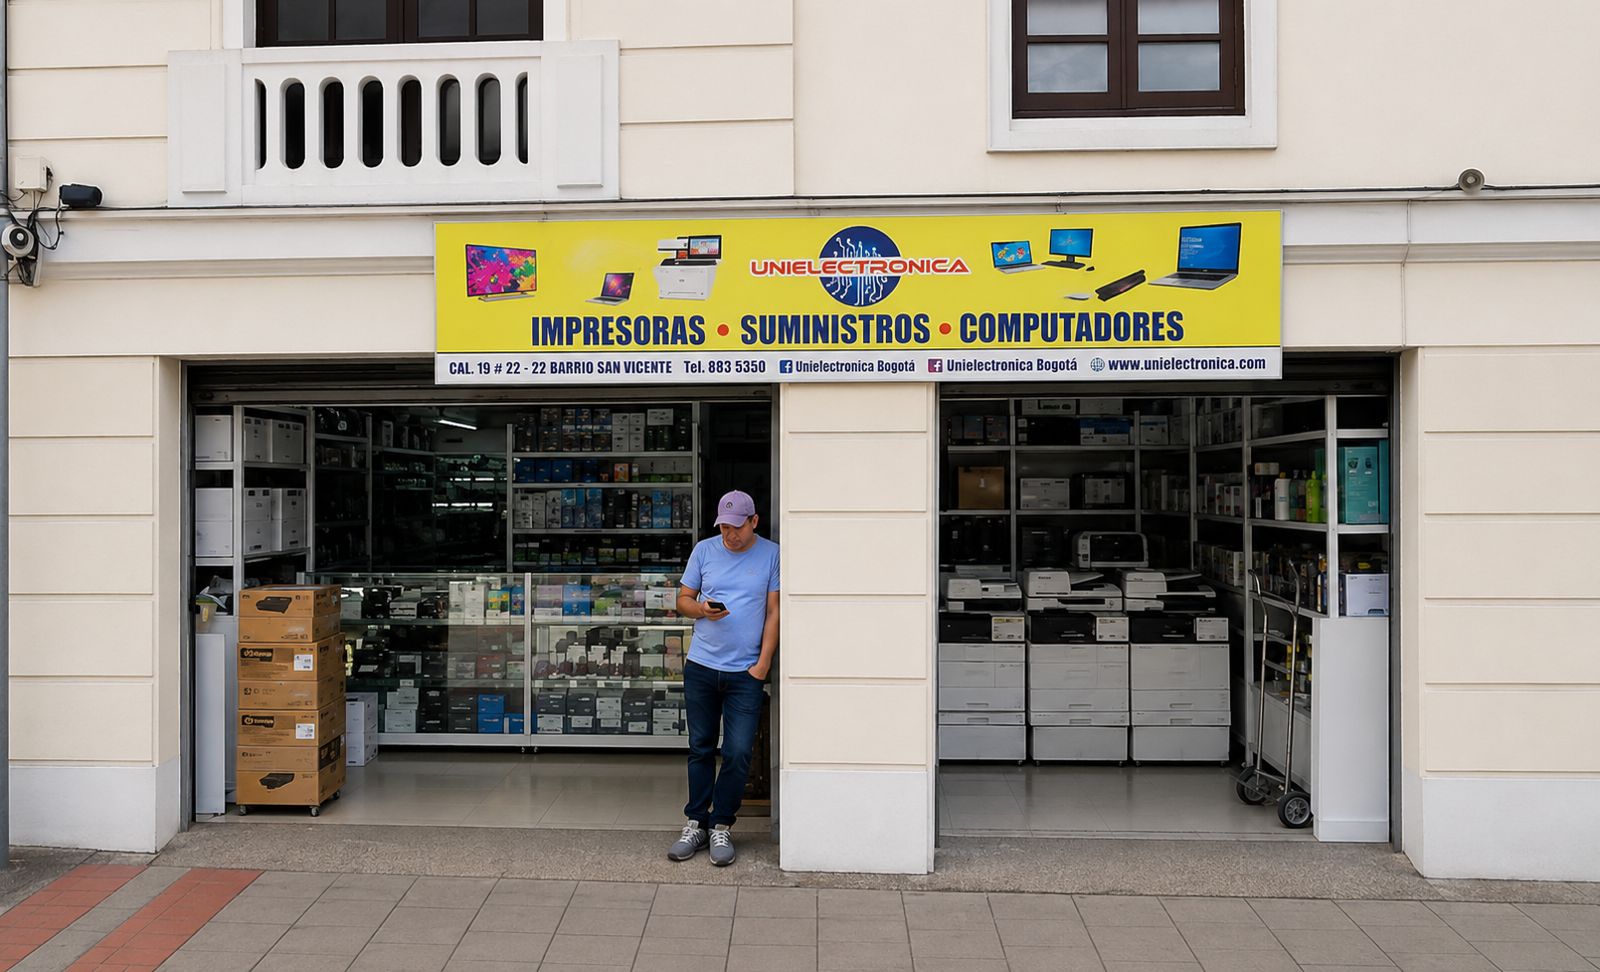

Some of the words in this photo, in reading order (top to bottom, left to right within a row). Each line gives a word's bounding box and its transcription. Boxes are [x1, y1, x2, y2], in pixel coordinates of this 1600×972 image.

[751, 259, 969, 275] UNIELECTRONICA
[532, 315, 706, 346] IMPRESORAS
[741, 313, 931, 345] SUMINISTROS
[960, 311, 1184, 344] COMPUTADORES
[449, 361, 475, 375] CAL.
[478, 361, 491, 375] 19
[494, 362, 503, 375] #
[506, 361, 521, 375] 22
[532, 361, 547, 375] 22
[550, 361, 594, 375] BARRIO
[597, 360, 621, 374] SAN
[624, 360, 673, 374] VICENTE
[684, 360, 706, 374] Tel.
[708, 360, 732, 374] 883
[735, 359, 766, 374] 5350
[795, 360, 874, 373] Unielectronica
[877, 359, 915, 374] Bogotá
[946, 359, 1033, 372] Unielectronica
[1036, 358, 1078, 373] Bogotá
[1108, 357, 1266, 371] www.unielectronica.com
